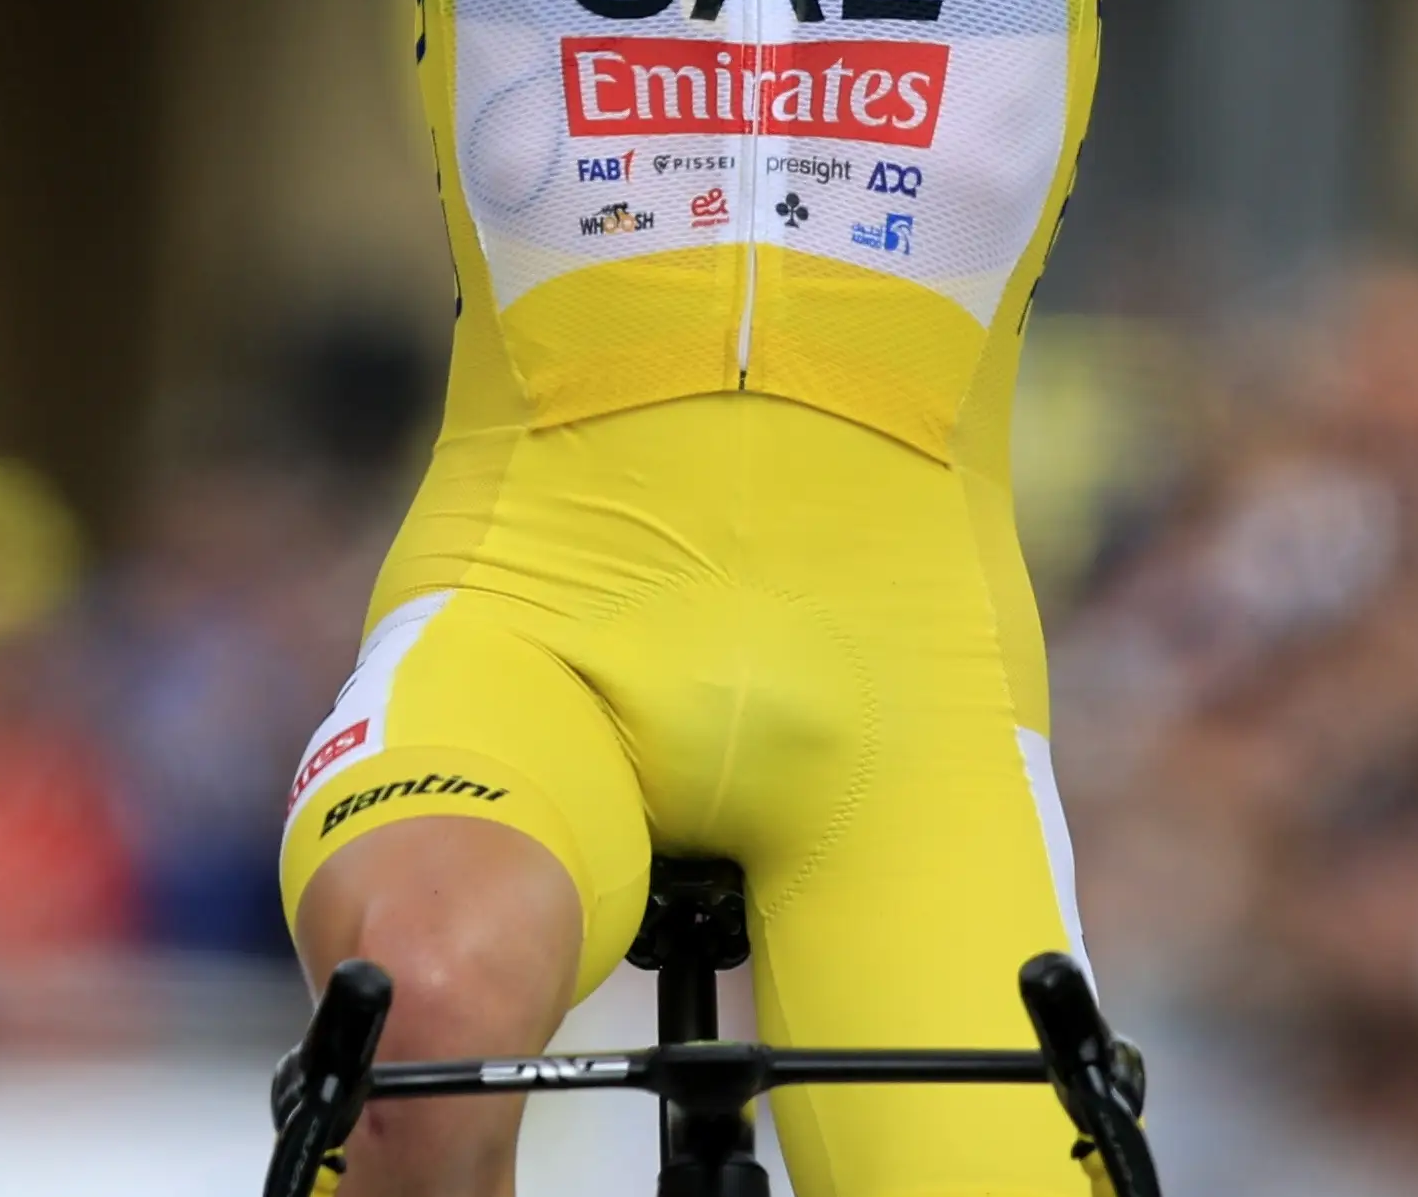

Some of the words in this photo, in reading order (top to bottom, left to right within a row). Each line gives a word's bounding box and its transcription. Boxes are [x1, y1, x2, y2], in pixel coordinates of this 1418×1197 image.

[574, 50, 931, 130] Emirates
[673, 156, 735, 170] PISSEI
[766, 156, 852, 185] presight
[319, 773, 511, 841] Santini
